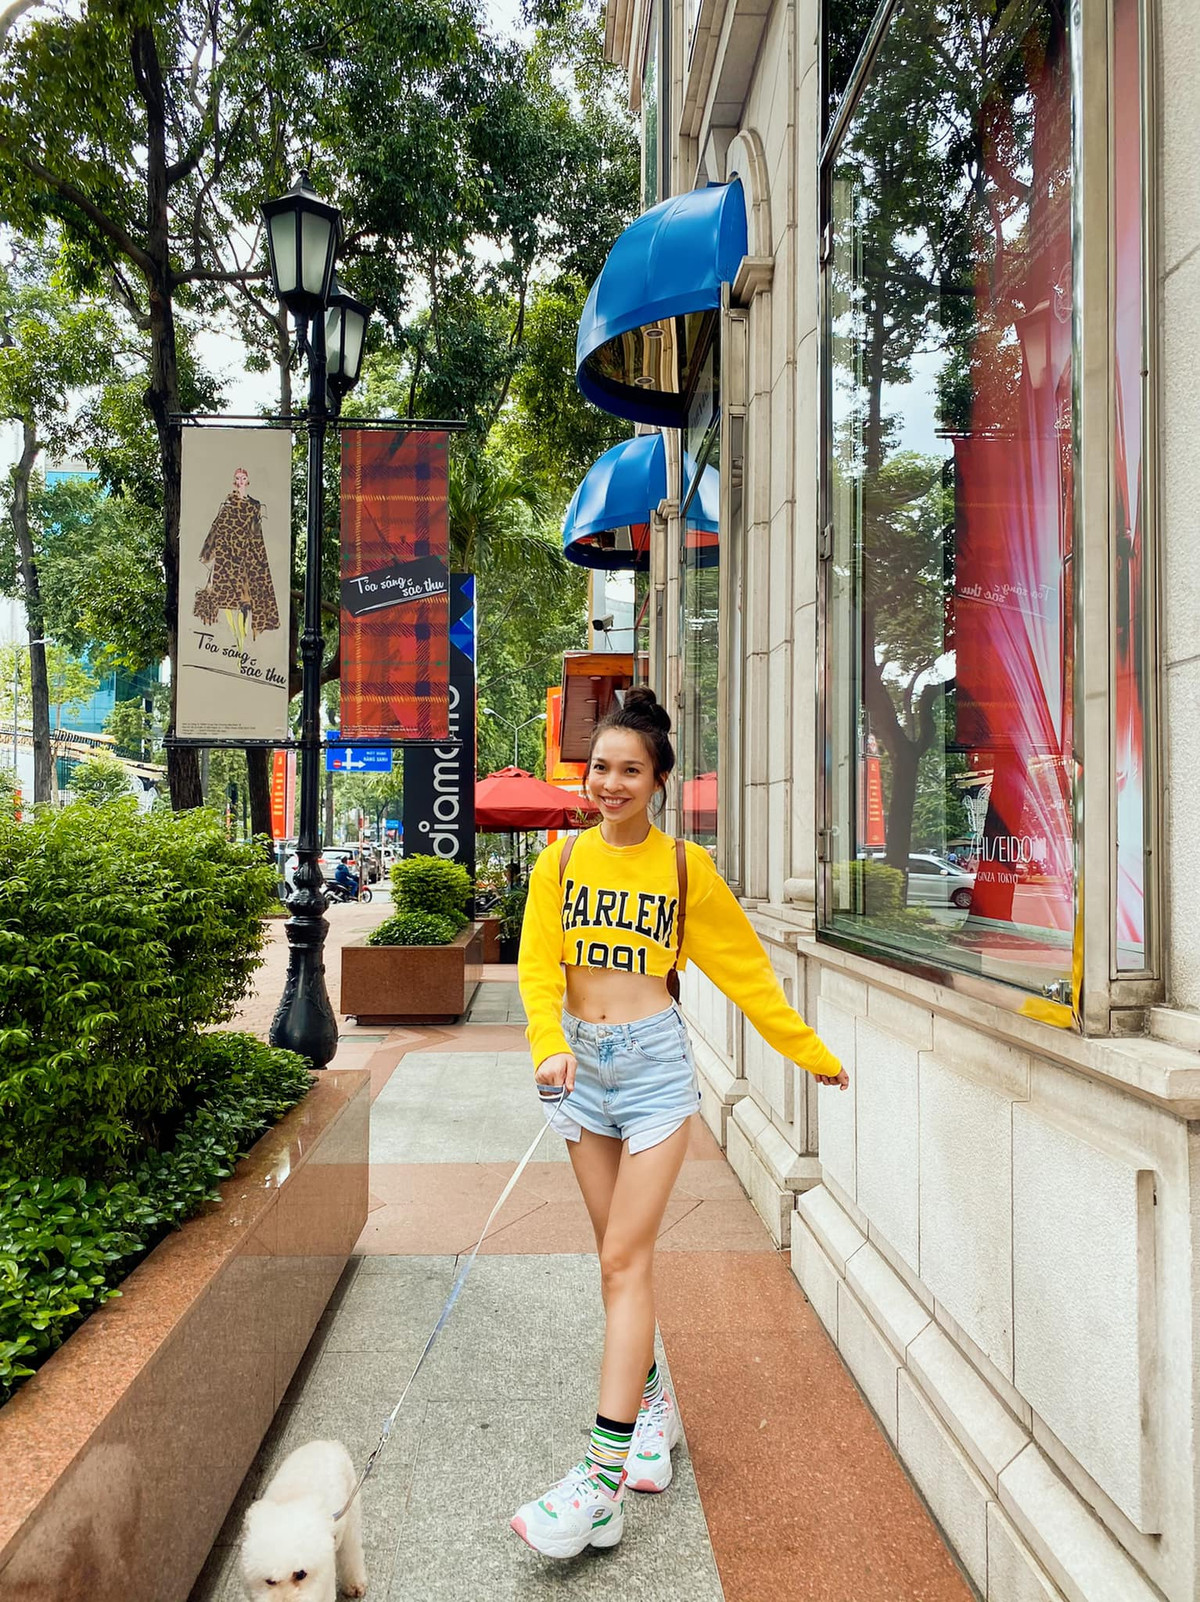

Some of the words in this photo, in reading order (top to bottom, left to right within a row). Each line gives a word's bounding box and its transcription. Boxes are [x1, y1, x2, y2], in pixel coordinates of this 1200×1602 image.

[424, 577, 444, 592] thu
[265, 668, 286, 684] thu
[965, 833, 1033, 864] SHISEIDO
[978, 871, 995, 882] GINZA
[997, 872, 1018, 884] TOKYO
[575, 940, 646, 975] 1991
